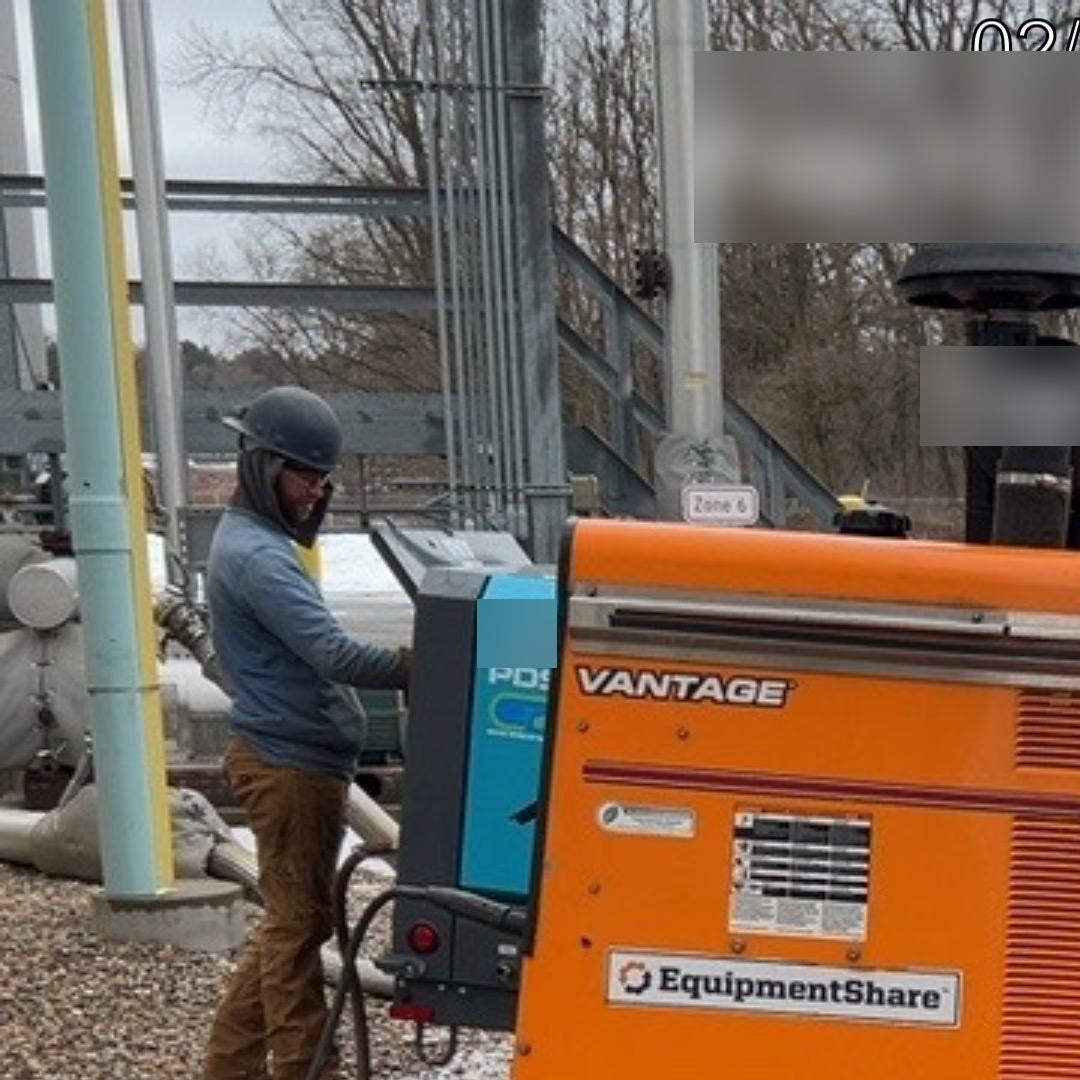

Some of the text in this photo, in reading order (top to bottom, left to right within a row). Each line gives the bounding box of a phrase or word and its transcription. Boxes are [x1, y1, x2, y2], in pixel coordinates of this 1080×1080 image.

[693, 494, 733, 514] Zone
[576, 666, 787, 707] VANTAGE
[658, 966, 941, 1010] EquipmentShare
